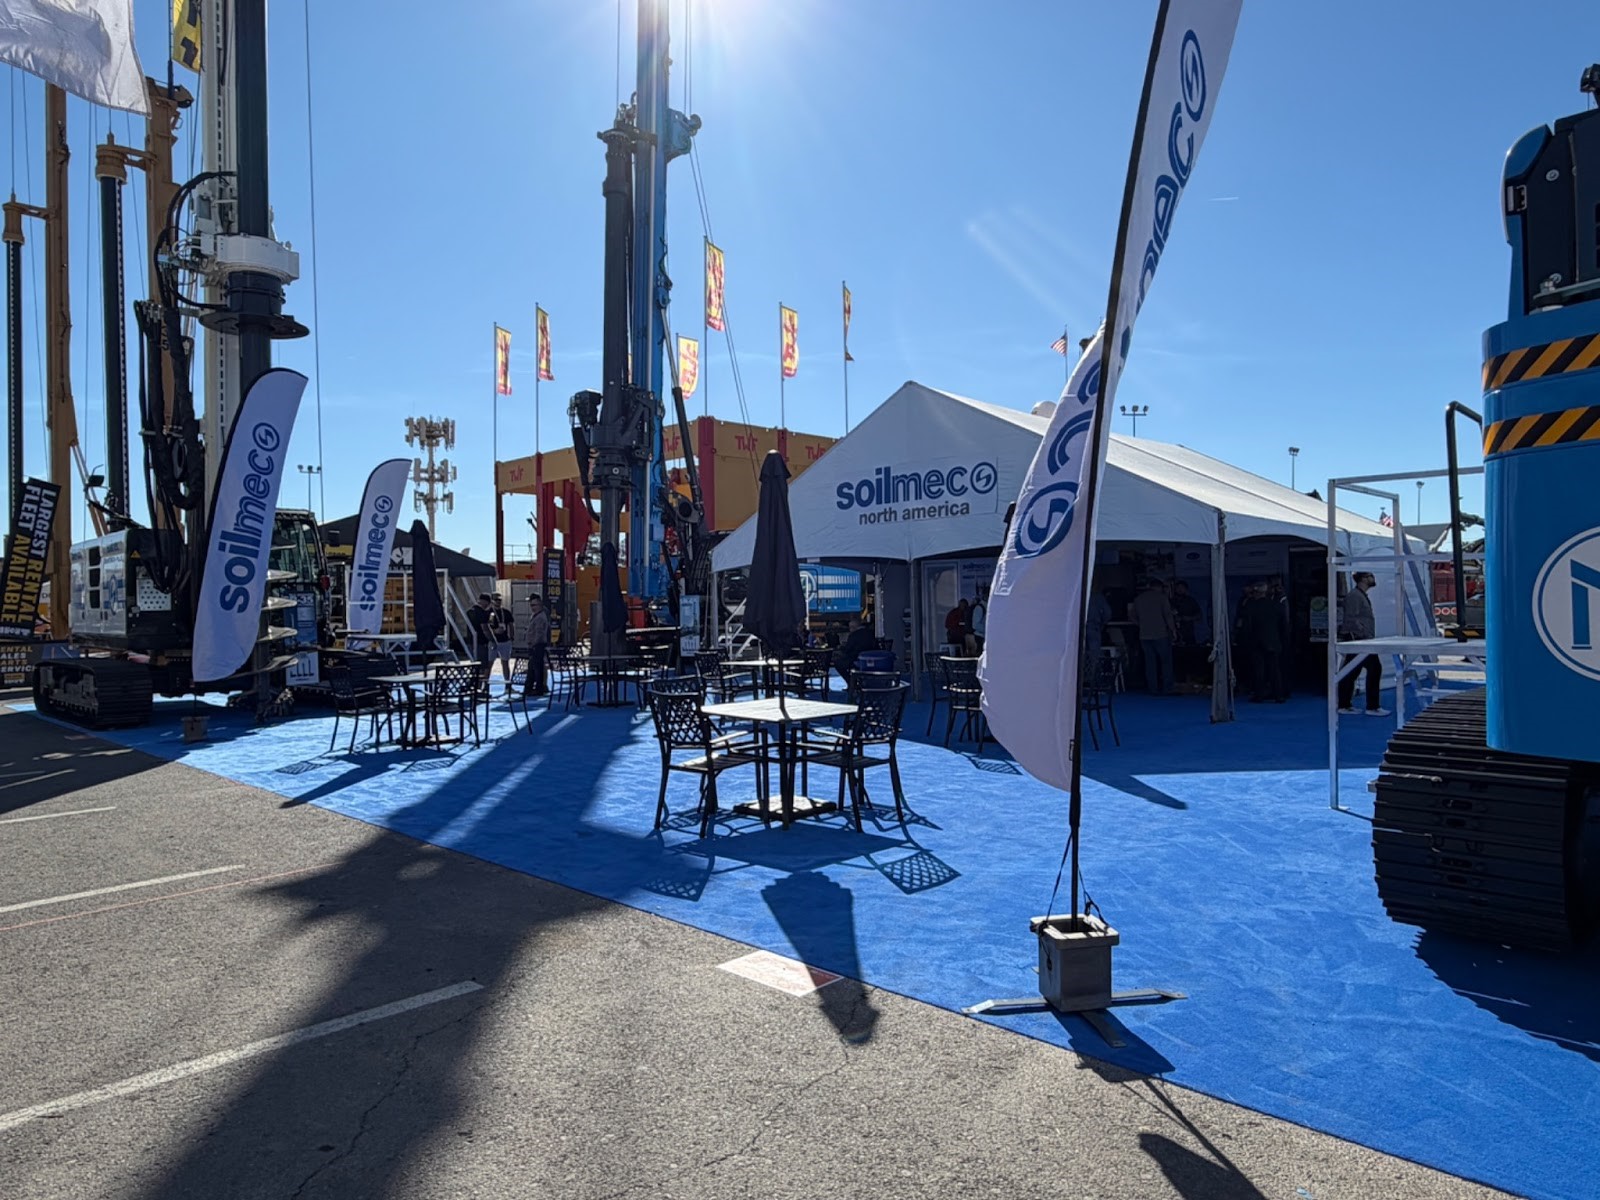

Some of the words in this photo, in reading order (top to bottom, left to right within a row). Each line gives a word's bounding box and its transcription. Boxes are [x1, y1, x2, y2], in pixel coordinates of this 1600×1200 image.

[18, 485, 41, 532] FLEET
[218, 422, 280, 613] soilmeco
[836, 462, 998, 510] soilmeco
[859, 507, 898, 525] north
[902, 501, 970, 521] america
[30, 489, 57, 558] LARGEST
[357, 495, 394, 611] soilmeco
[1, 534, 31, 623] AVAILABLE
[18, 558, 44, 623] RENTAL
